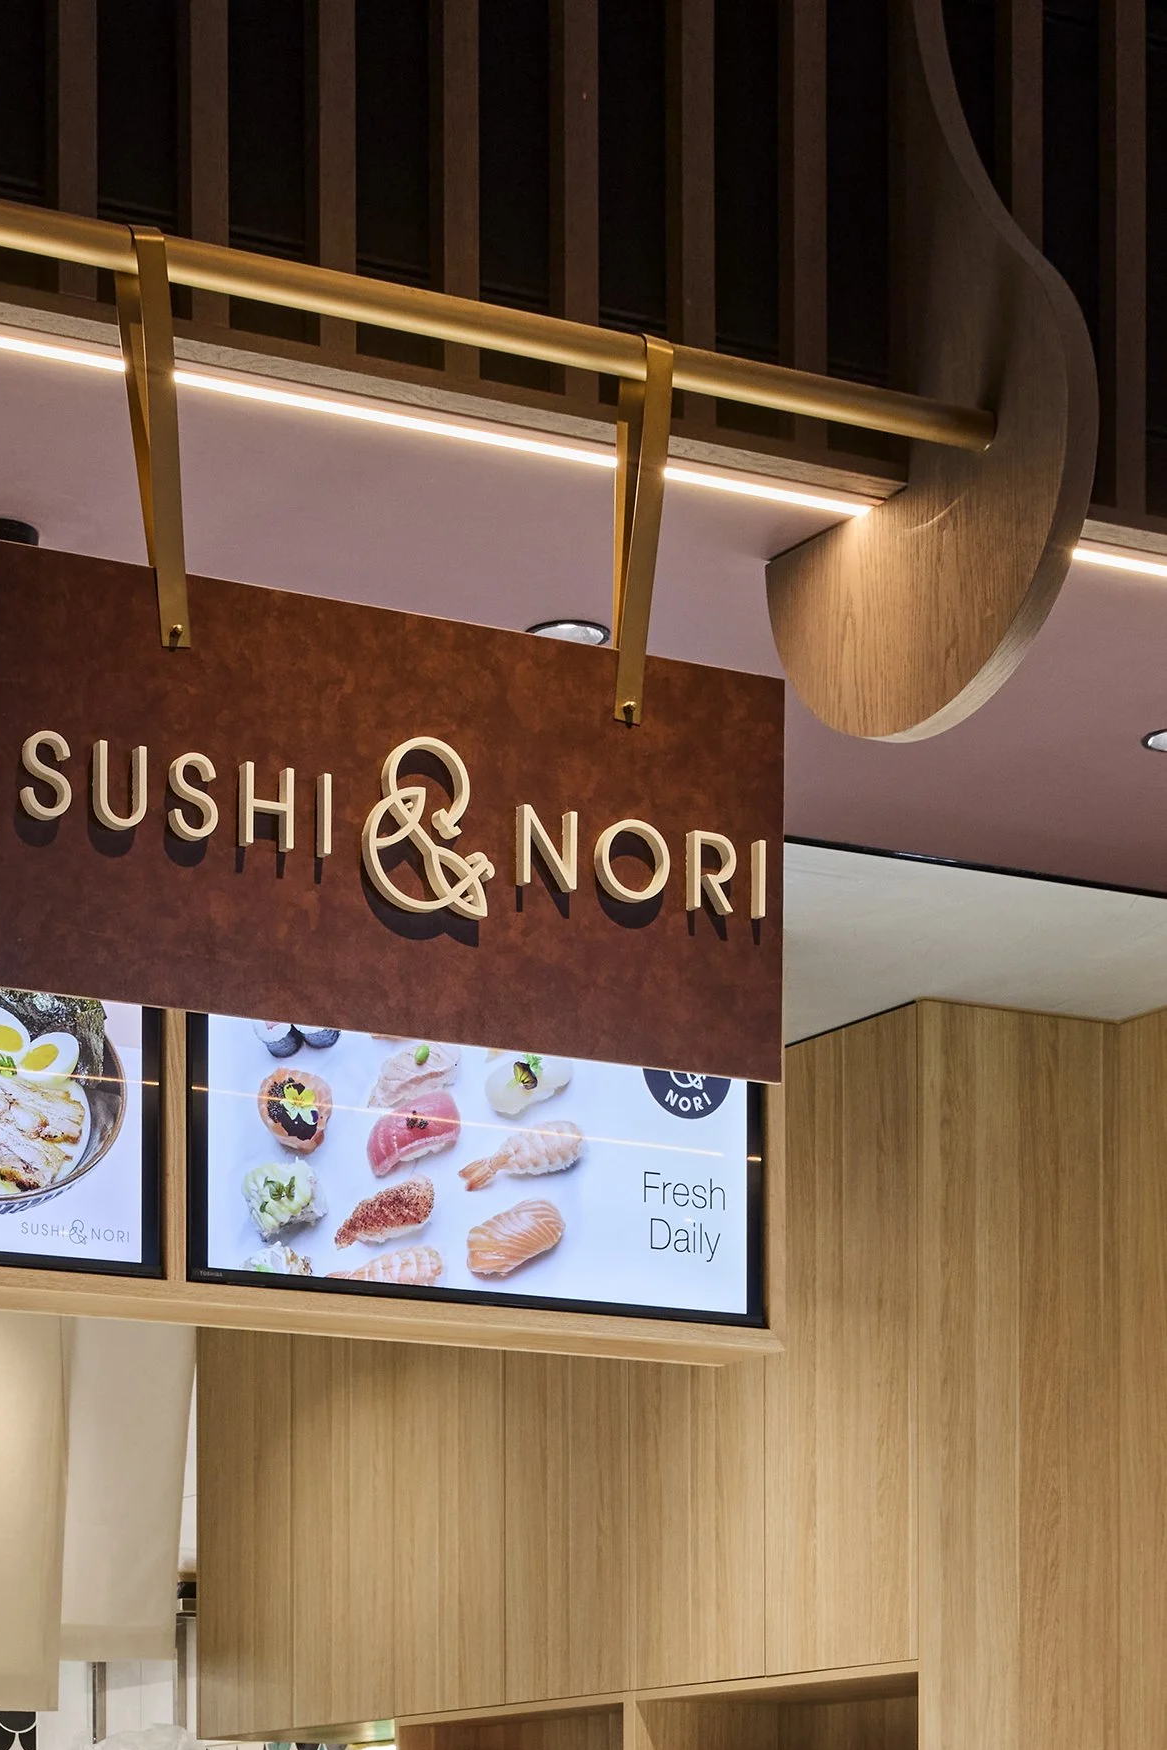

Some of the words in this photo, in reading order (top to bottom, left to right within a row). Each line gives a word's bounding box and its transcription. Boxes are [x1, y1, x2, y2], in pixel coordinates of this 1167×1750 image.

[20, 730, 332, 858] SUSHI
[362, 735, 495, 922] &
[515, 803, 768, 919] NORI
[664, 1089, 712, 1112] NORI
[643, 1171, 725, 1210] Fresh
[21, 1221, 64, 1237] SUSHI
[69, 1219, 87, 1245] &
[91, 1229, 130, 1243] NORI
[650, 1218, 721, 1262] Daily
